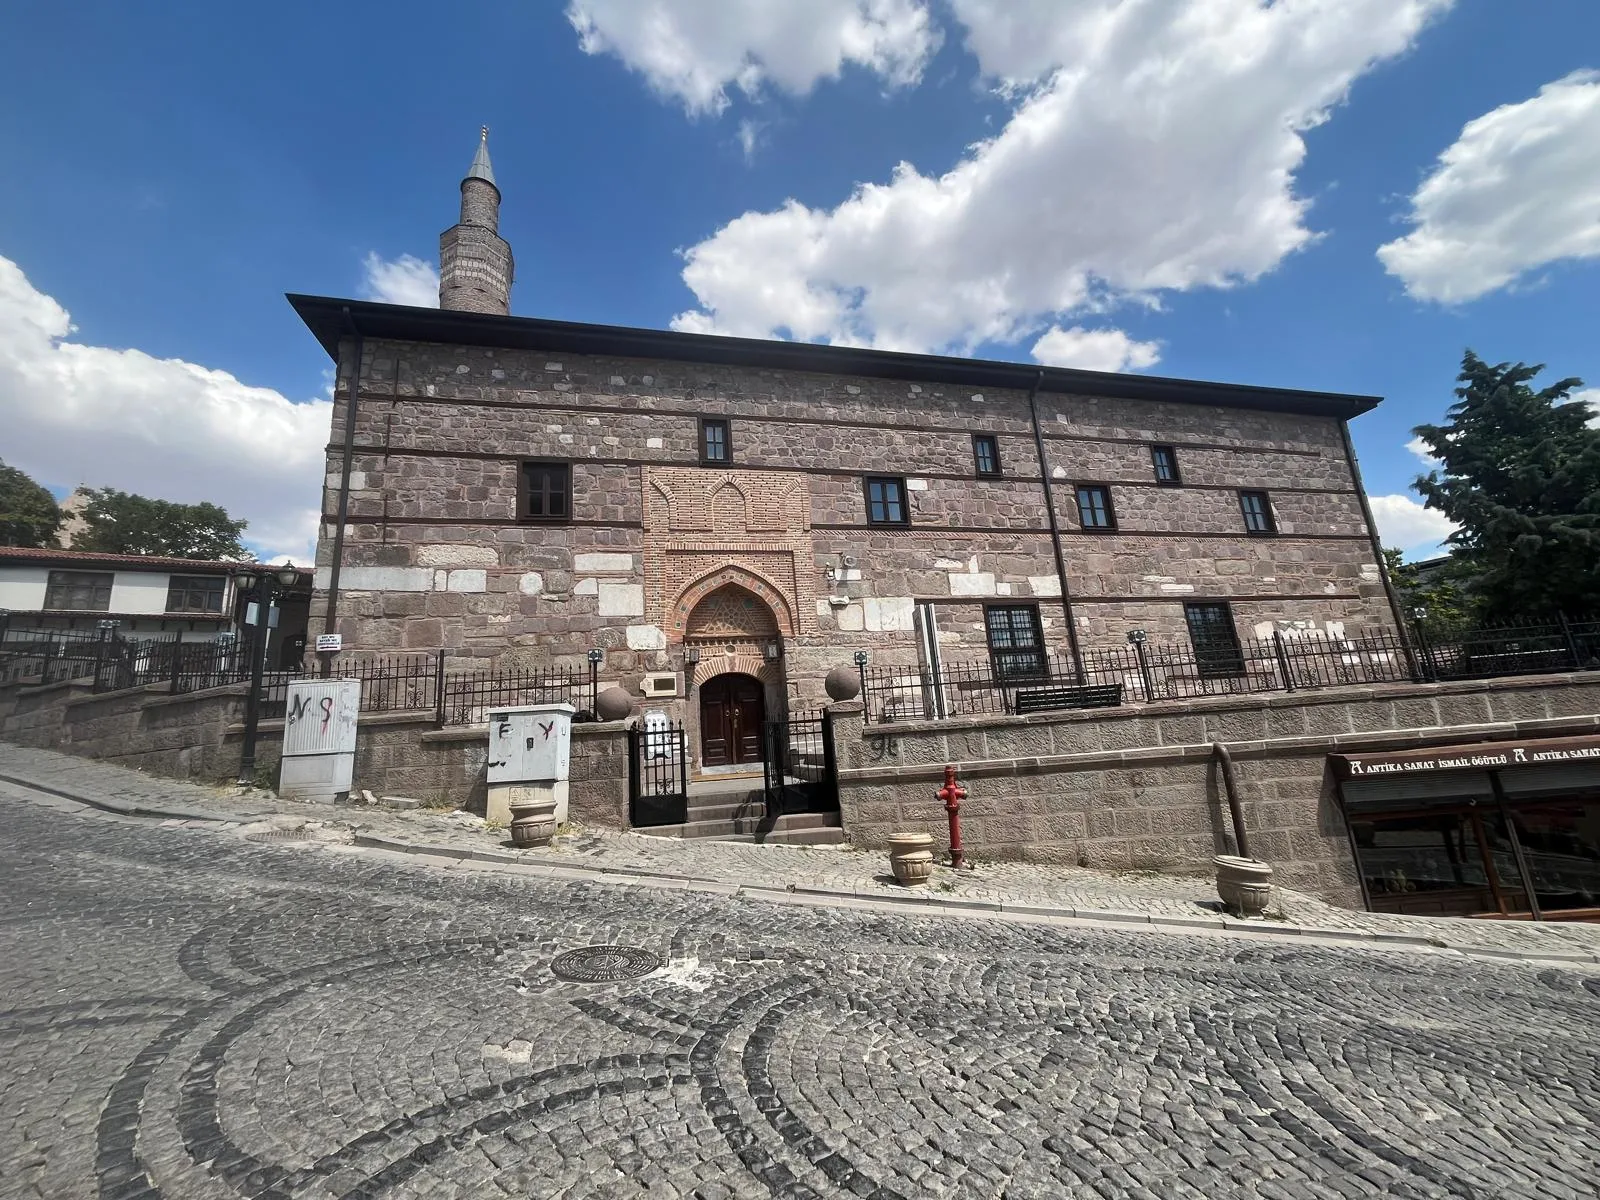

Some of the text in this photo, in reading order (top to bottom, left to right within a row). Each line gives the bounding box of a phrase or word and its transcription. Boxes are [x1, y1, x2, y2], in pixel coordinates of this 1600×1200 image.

[1366, 762, 1403, 774] ANTİKA
[1403, 760, 1435, 771] SANAT
[1438, 758, 1471, 769] İSMAİL
[1471, 754, 1507, 766] ÖĞÜTLÜ
[1533, 750, 1570, 761] ANTİKA
